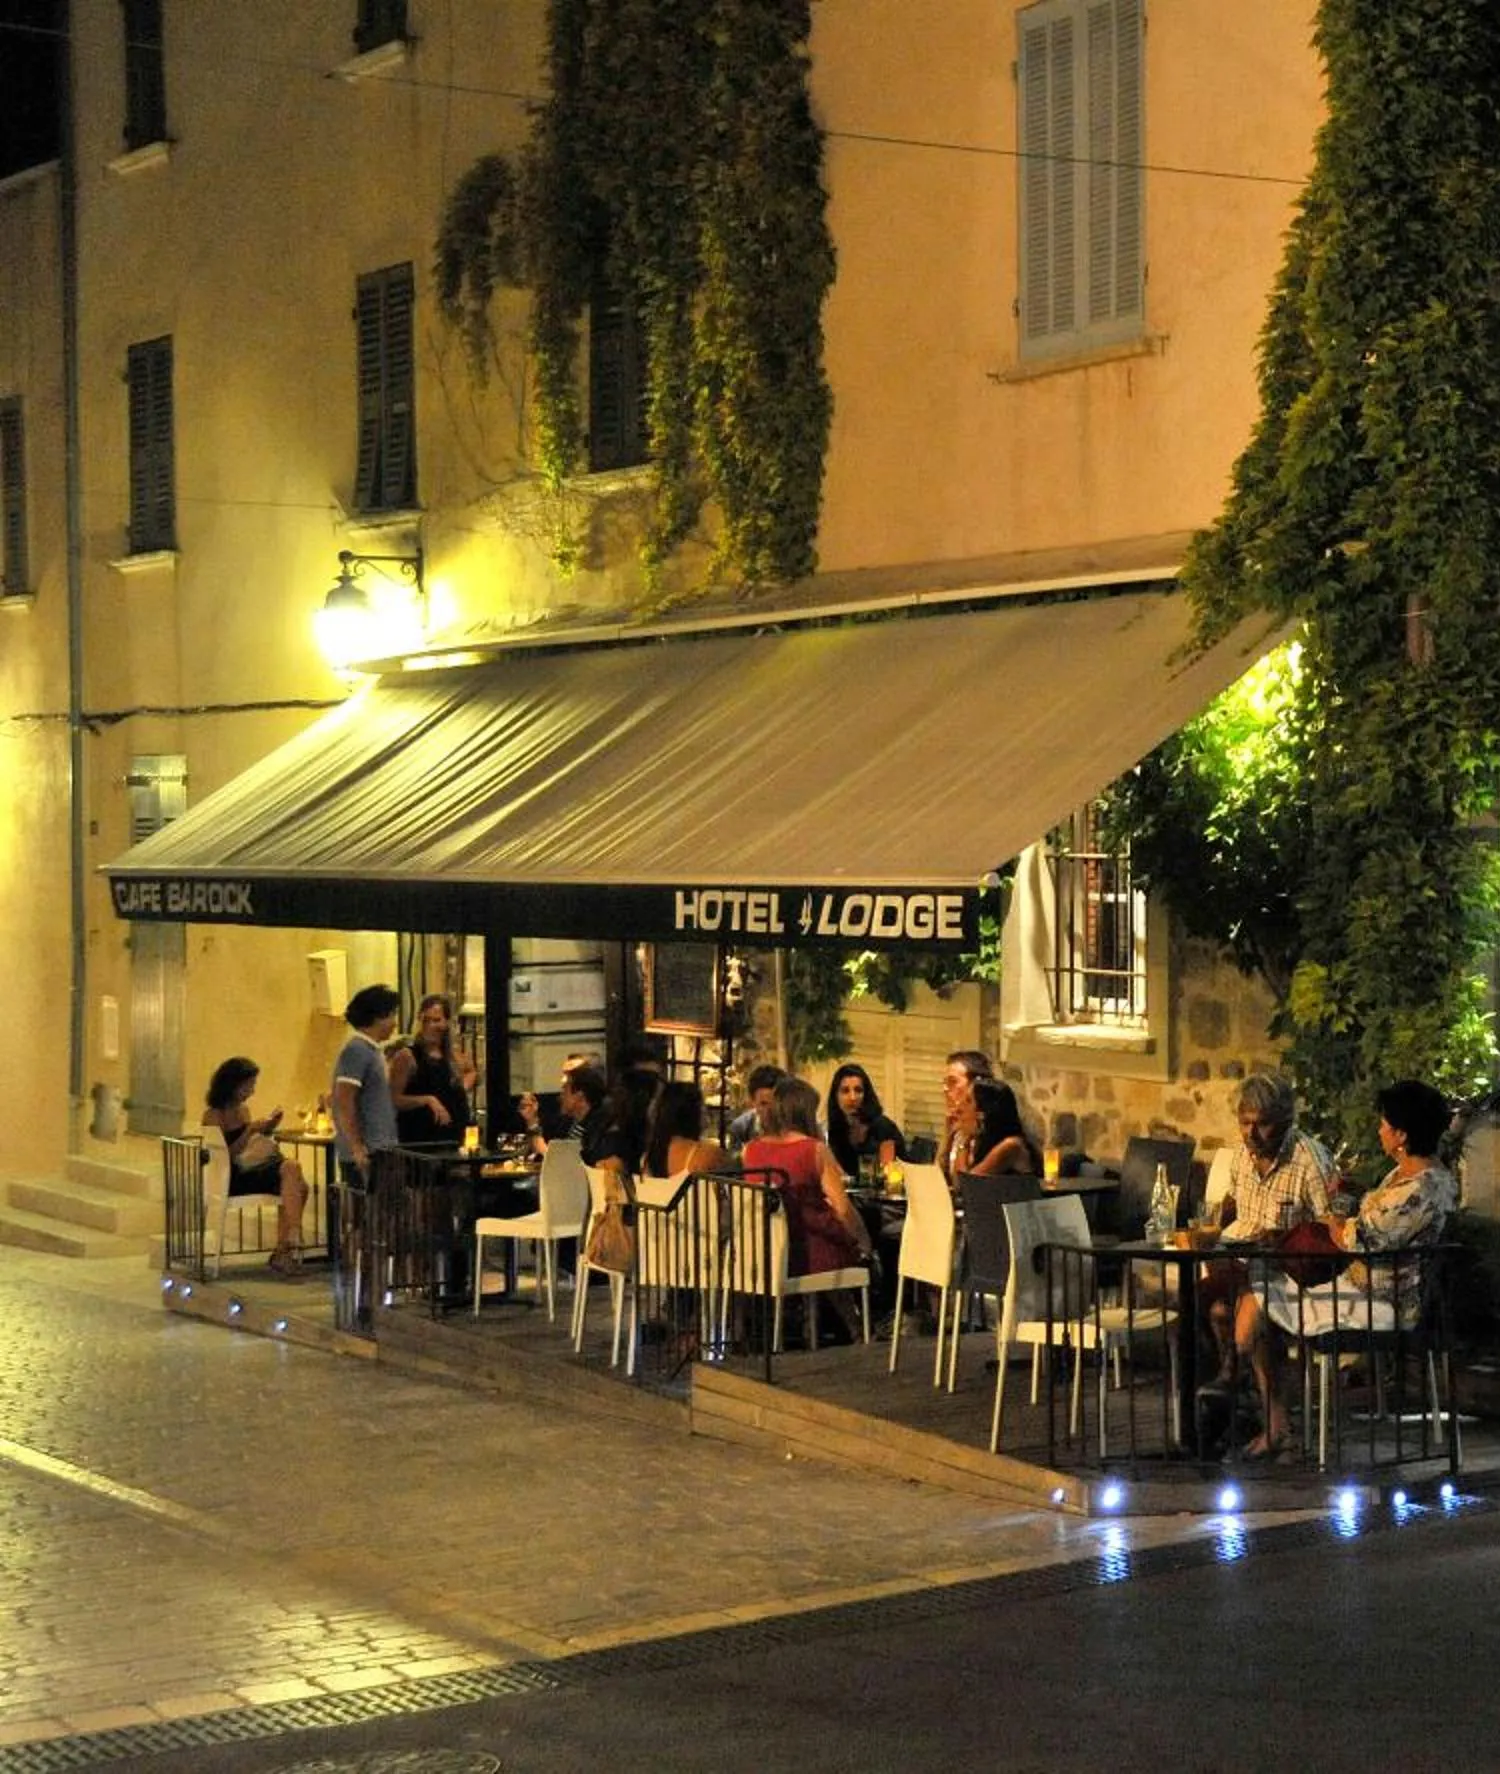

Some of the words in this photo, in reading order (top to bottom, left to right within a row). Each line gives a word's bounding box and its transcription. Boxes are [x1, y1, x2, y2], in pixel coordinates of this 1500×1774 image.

[115, 882, 162, 913] CAFE
[167, 882, 254, 915] BAROCK
[675, 890, 785, 933] HOTEL
[816, 894, 964, 939] LODGE
